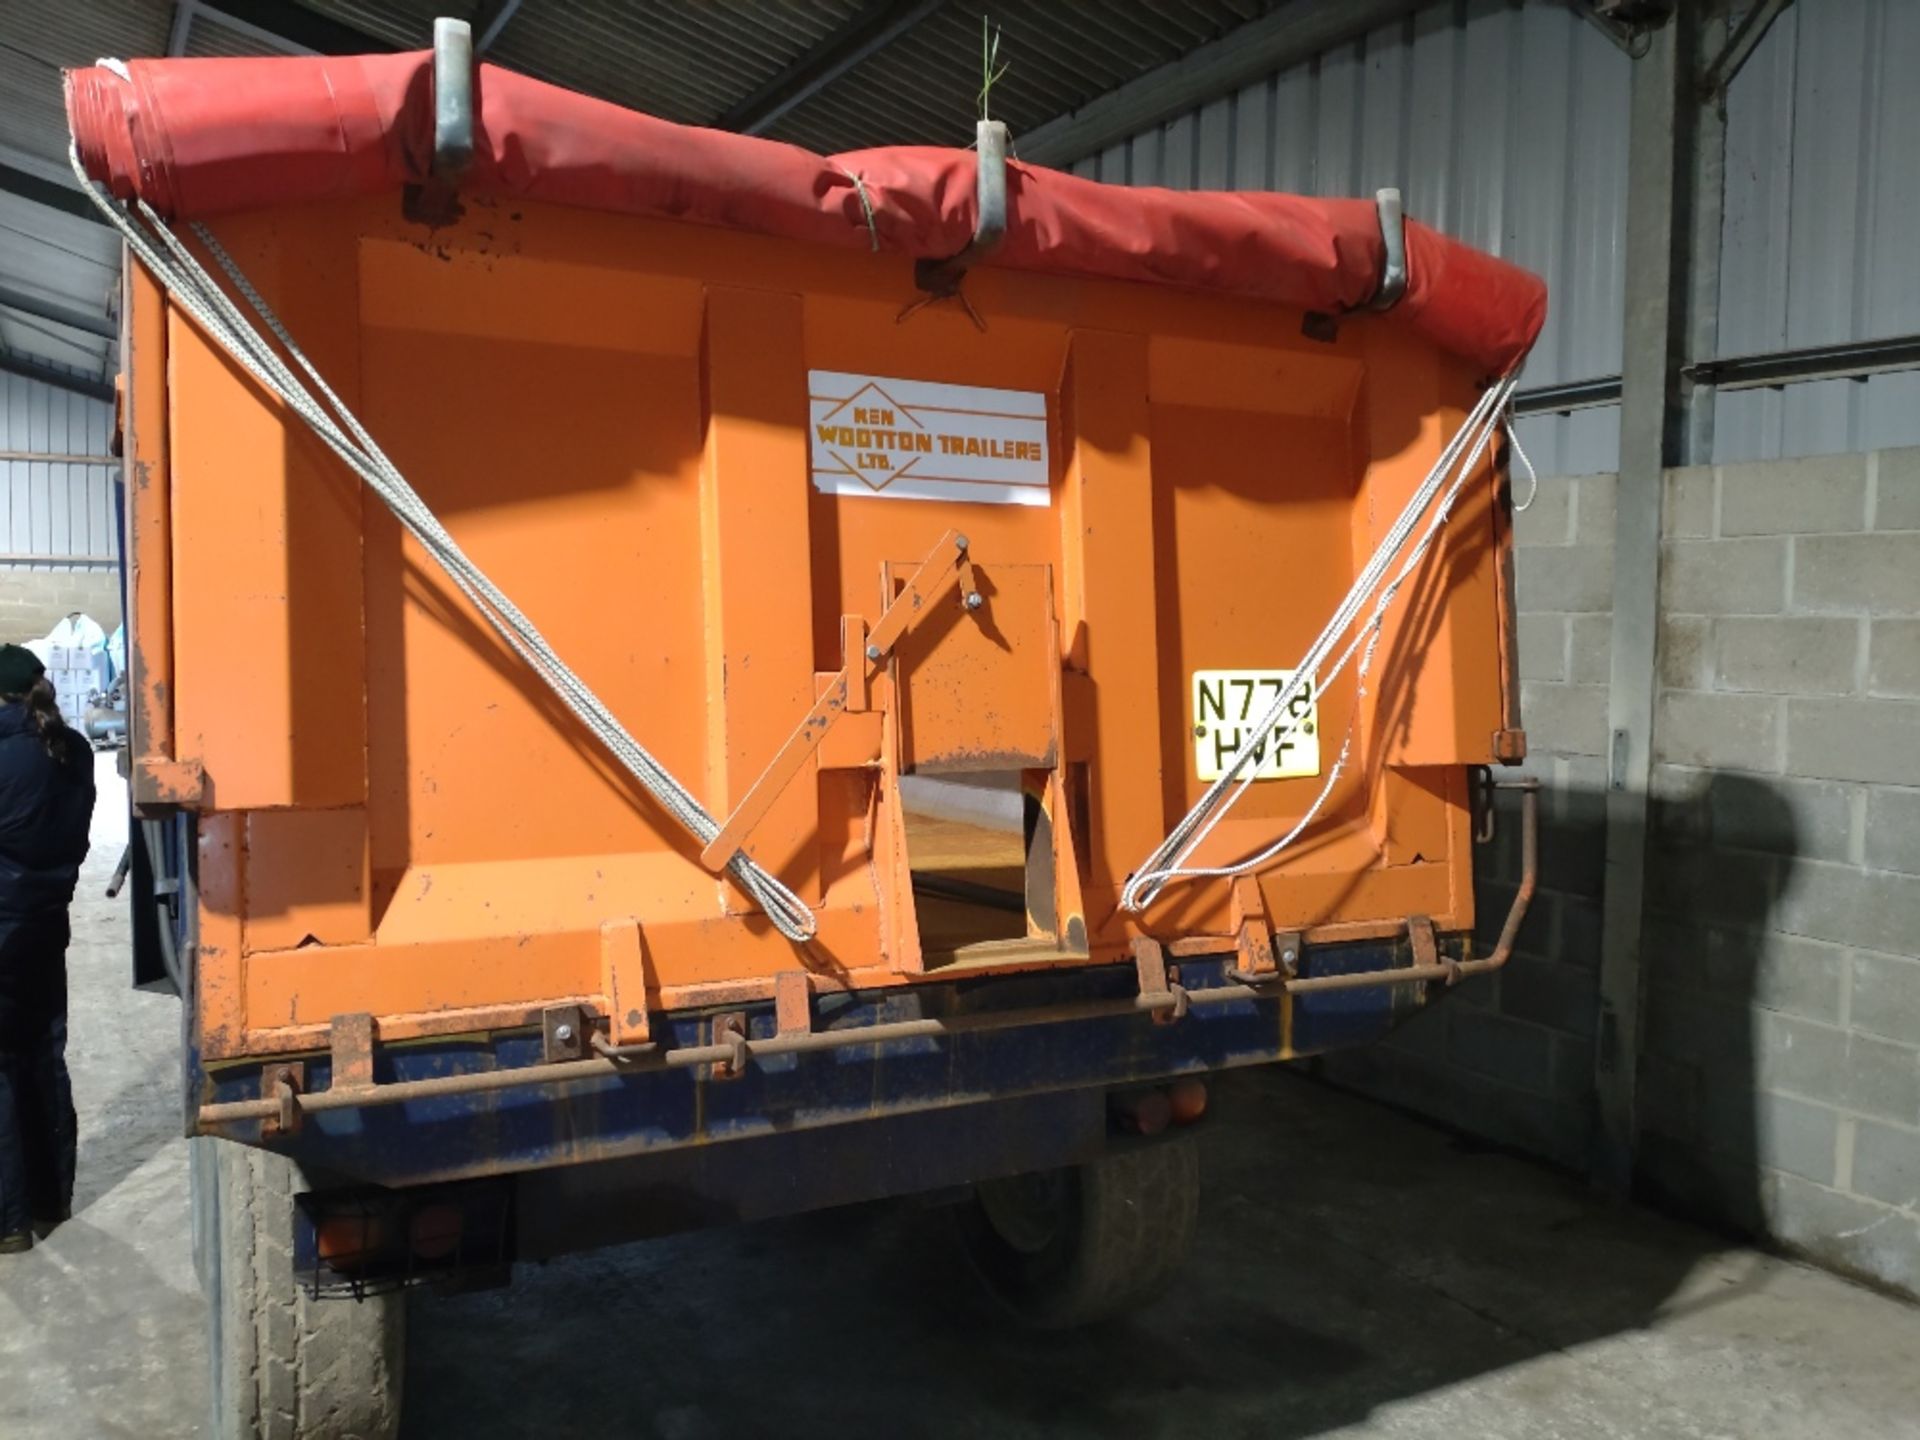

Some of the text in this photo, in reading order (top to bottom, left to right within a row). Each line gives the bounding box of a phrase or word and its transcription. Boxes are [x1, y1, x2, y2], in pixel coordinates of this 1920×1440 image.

[854, 406, 894, 426] KEN
[816, 424, 1041, 461] WOOTTON TRAILERS
[856, 452, 895, 471] LTD.
